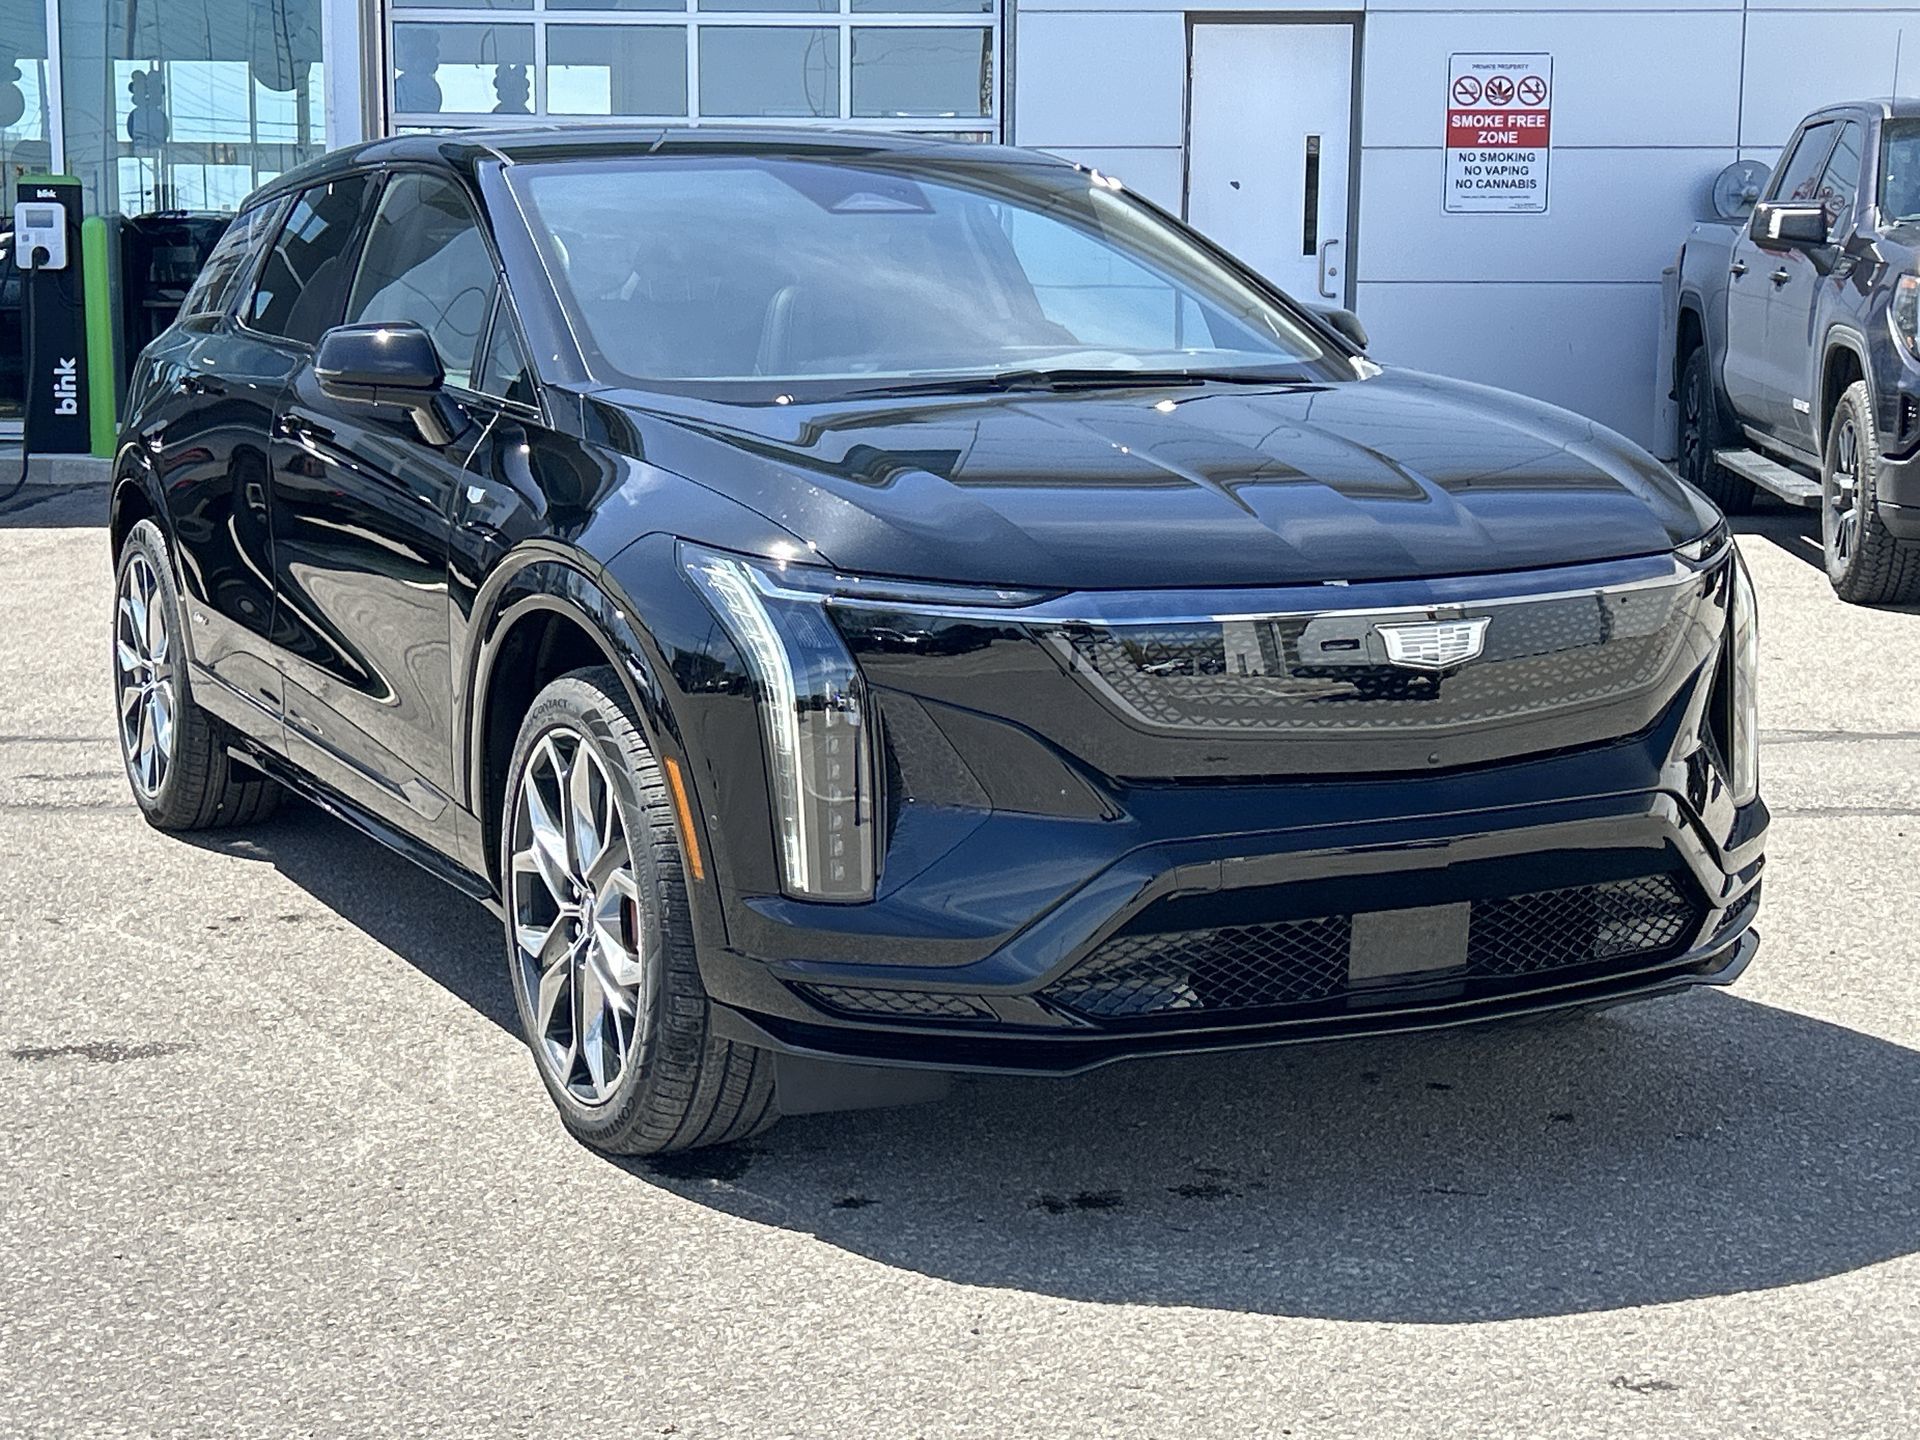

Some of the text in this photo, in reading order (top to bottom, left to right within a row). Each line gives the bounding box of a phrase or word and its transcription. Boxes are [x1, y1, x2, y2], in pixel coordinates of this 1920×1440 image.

[1451, 115, 1546, 128] SMOKE FREE
[1477, 131, 1518, 144] ZONE
[1458, 152, 1536, 162] NO SMOKING
[1464, 165, 1529, 175] NO VAPING
[1455, 179, 1537, 189] NO CANNABIS
[54, 357, 77, 416] blink
